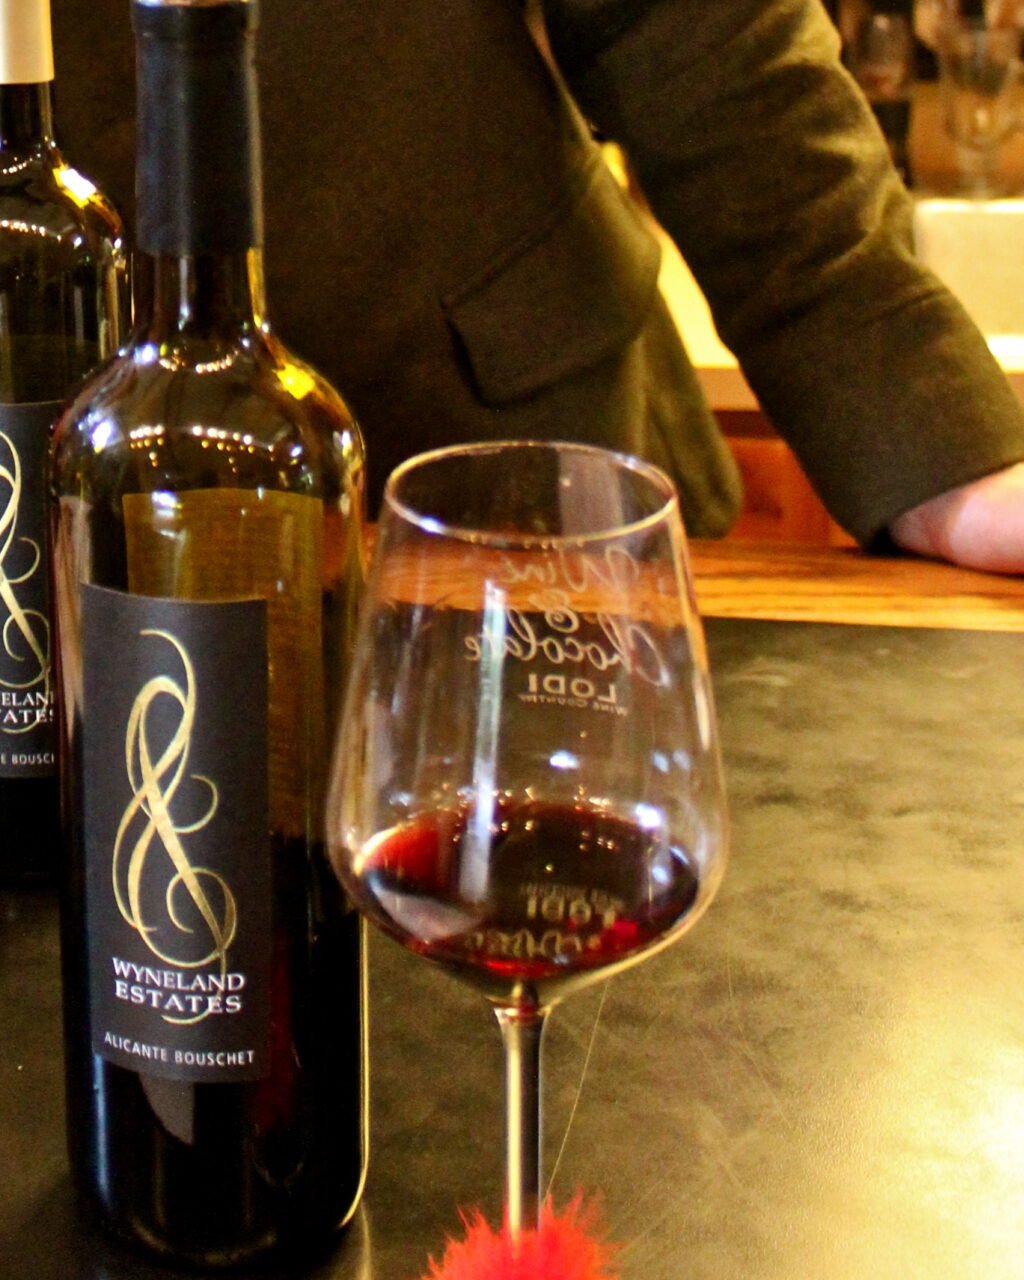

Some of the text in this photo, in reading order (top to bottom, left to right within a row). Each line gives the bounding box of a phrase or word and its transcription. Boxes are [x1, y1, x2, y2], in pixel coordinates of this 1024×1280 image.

[11, 752, 55, 766] BOUSC
[112, 956, 246, 992] WYNELAND
[114, 979, 243, 1015] ESTATES
[104, 1030, 256, 1068] ALICANTE BOUSCHET
